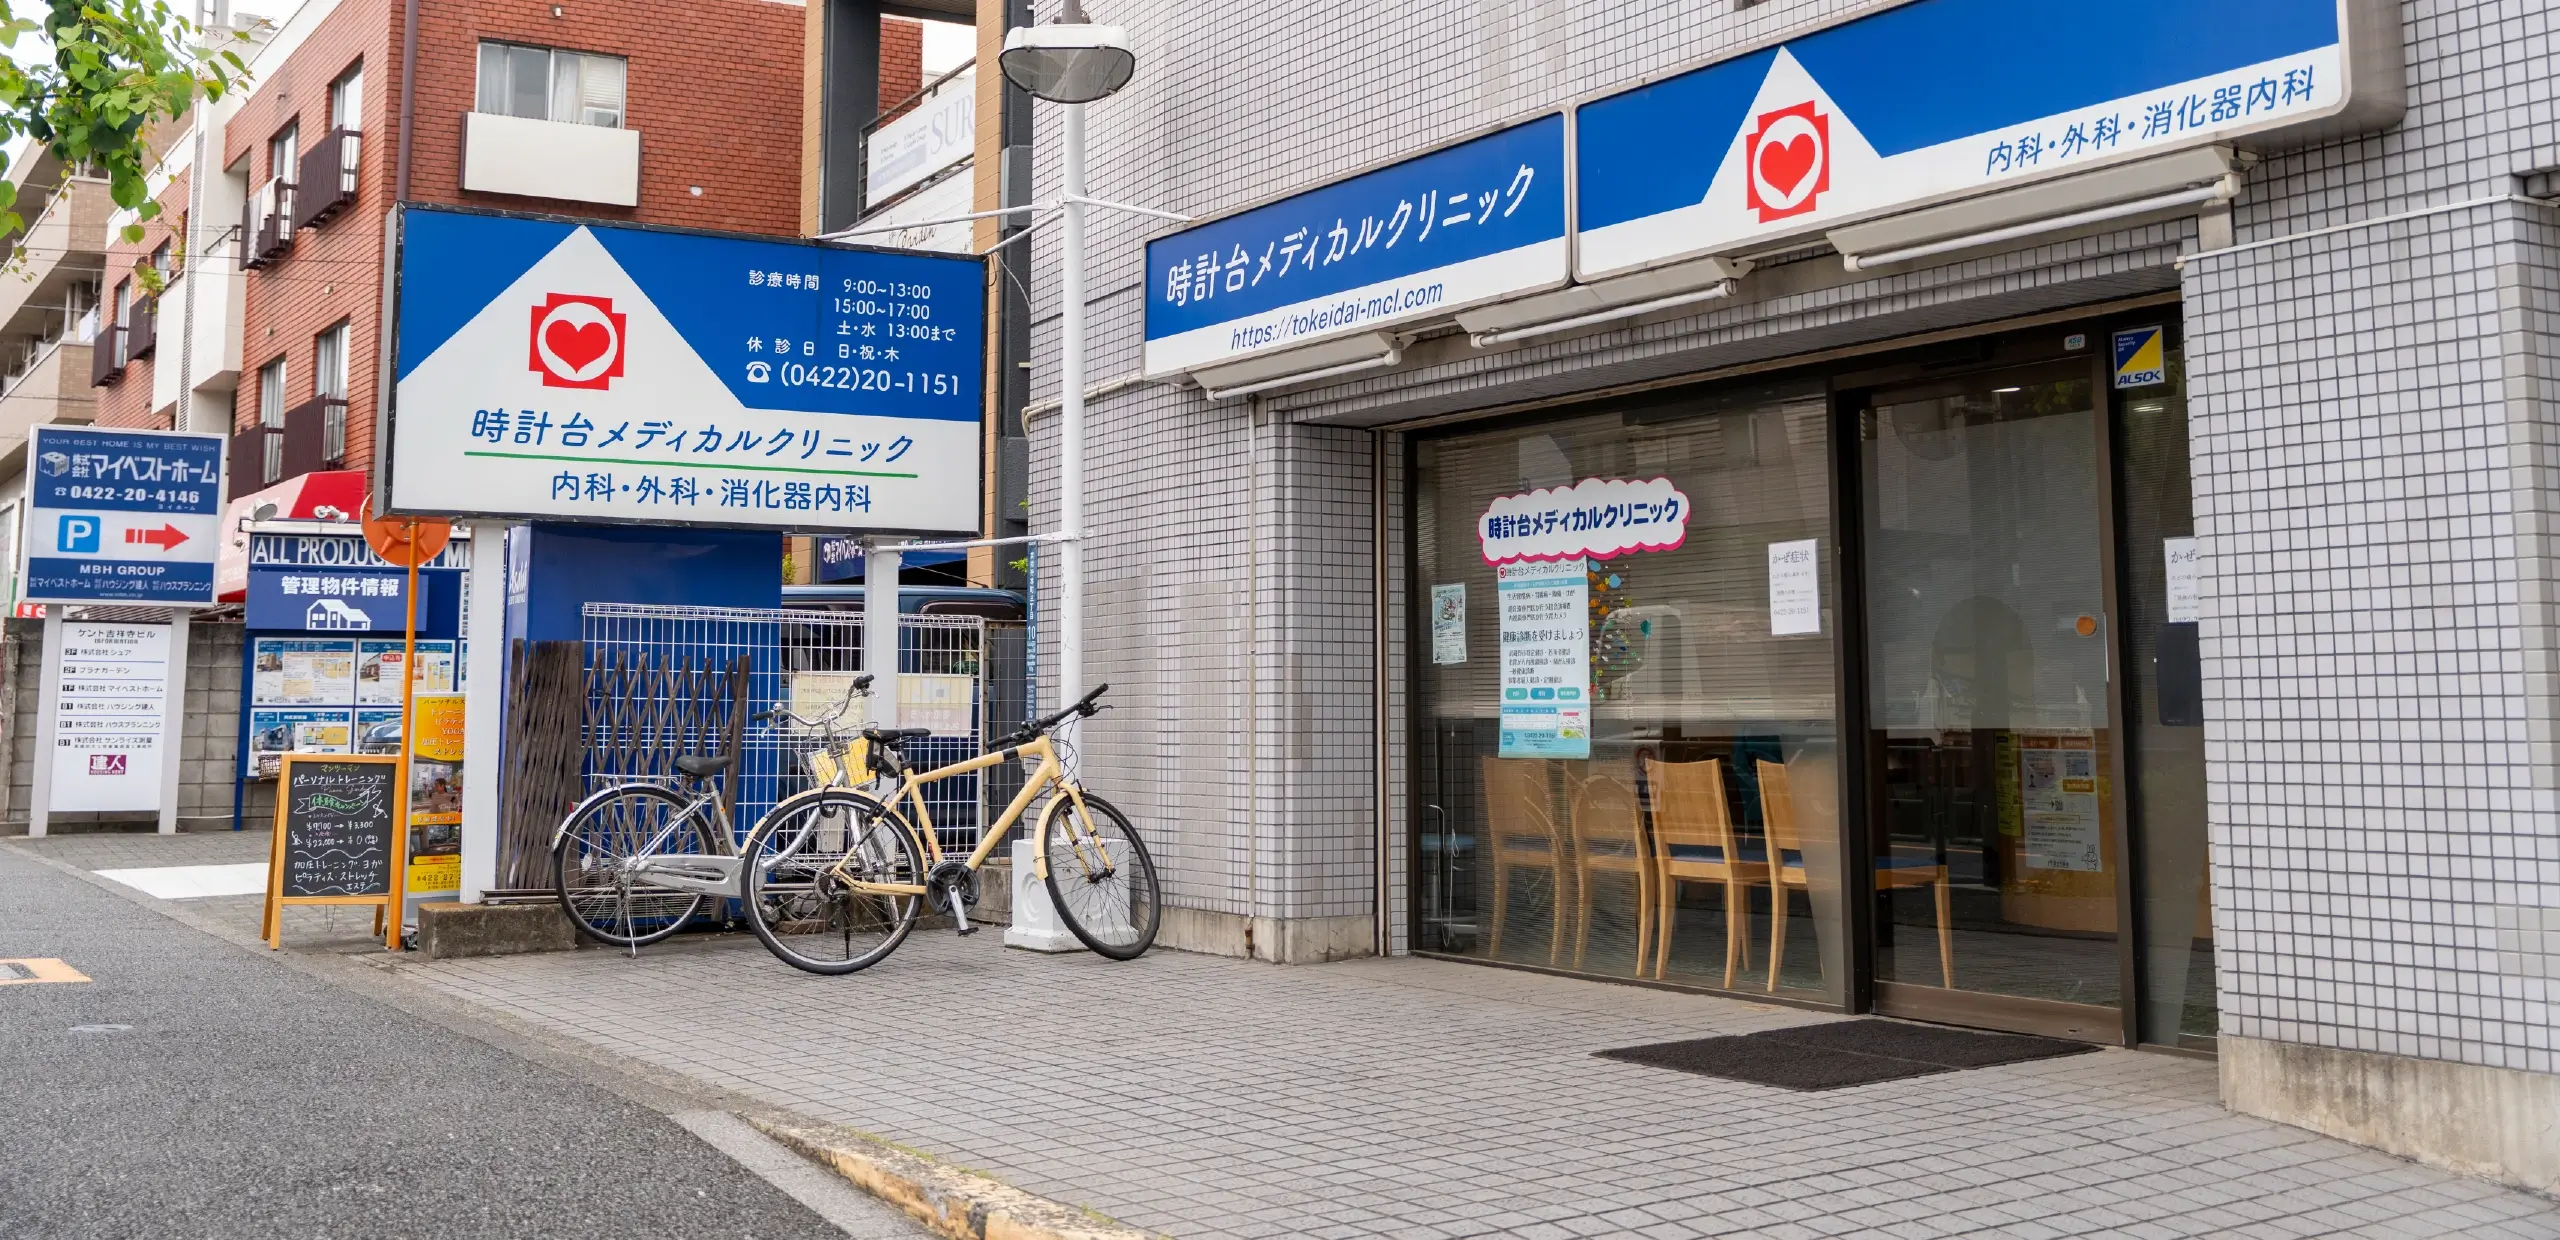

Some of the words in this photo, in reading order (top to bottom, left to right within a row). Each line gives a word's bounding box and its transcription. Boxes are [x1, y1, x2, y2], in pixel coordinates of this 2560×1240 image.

[1985, 65, 2314, 175] 内科・外科・消化器内科
[1166, 163, 1537, 307] 時計台メディカルクリニック
[748, 270, 820, 291] 診療時間
[843, 278, 931, 299] 9:00~13:00
[834, 298, 930, 320] 15:00~17:00
[1230, 281, 1442, 351] https://tokeidai-mcl.com
[836, 321, 876, 337] 土・水
[888, 322, 956, 342] 13:00まで
[838, 344, 899, 361] 日・祝・木
[780, 361, 960, 396] (0422)20-1151
[2118, 371, 2160, 385] ALSOK
[102, 440, 129, 448] HOME
[133, 441, 142, 449] IS
[146, 442, 160, 450] MY
[163, 443, 188, 451] BEST
[191, 444, 216, 452] WISH
[471, 407, 914, 464] 時計台メディカルクリニック
[91, 454, 217, 484] マイベストホーム
[70, 485, 200, 504] 0422-20-4146
[551, 471, 871, 513] 内科・外科・消化器内科
[1488, 498, 1679, 539] 時計台メディカルクリニック
[66, 520, 92, 549] P
[254, 536, 290, 563] ALL
[1772, 549, 1810, 564] かぜ症状
[80, 565, 112, 574] MBH
[117, 566, 166, 576] GROUP
[1507, 563, 1585, 576] 時計台メディカルクリニック
[282, 576, 399, 597] 管理物件情報
[1028, 626, 1036, 639] 10
[1503, 628, 1584, 643] 健康診断を受けましょう
[294, 774, 386, 786] パーソナルトレーニング
